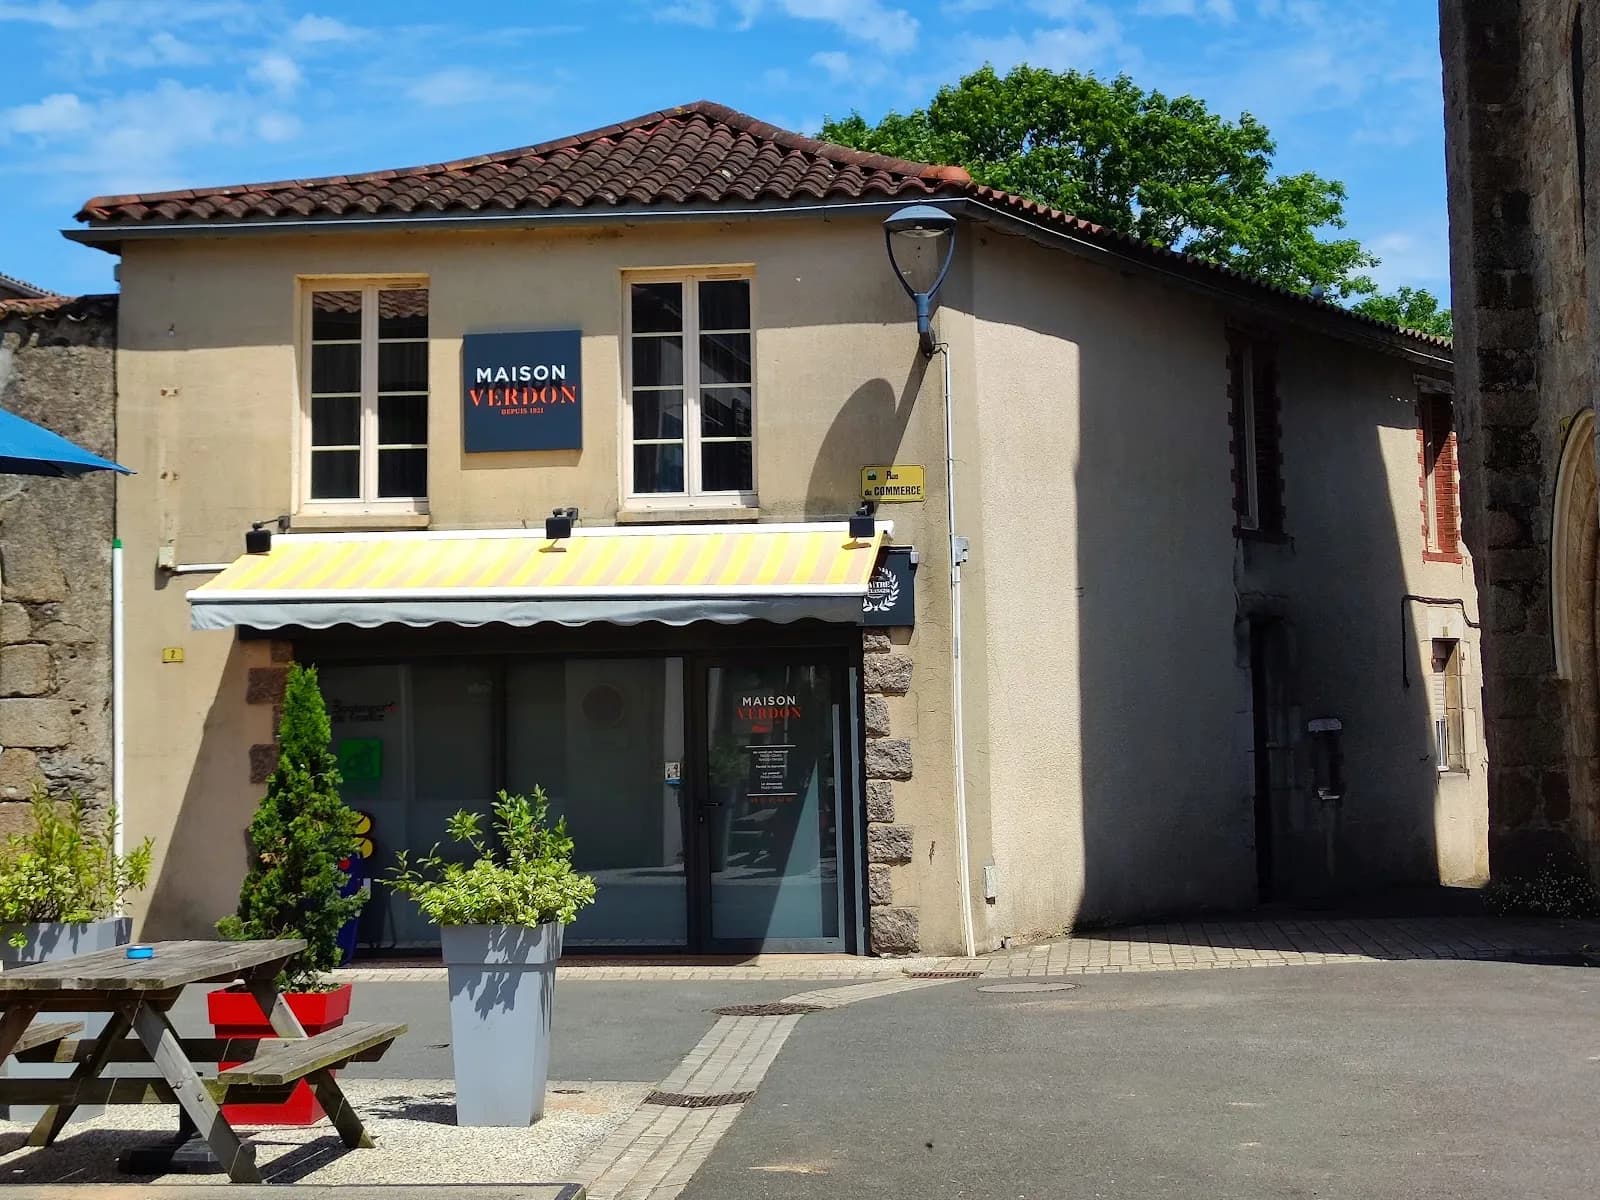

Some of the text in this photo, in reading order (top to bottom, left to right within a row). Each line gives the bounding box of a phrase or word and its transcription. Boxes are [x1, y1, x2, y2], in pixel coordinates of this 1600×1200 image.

[476, 364, 566, 383] MAISON
[469, 384, 577, 407] VERDON
[501, 407, 528, 415] DEPUIS
[874, 485, 921, 496] COMMERCE
[742, 695, 796, 707] MAISON
[737, 706, 803, 720] VERDON
